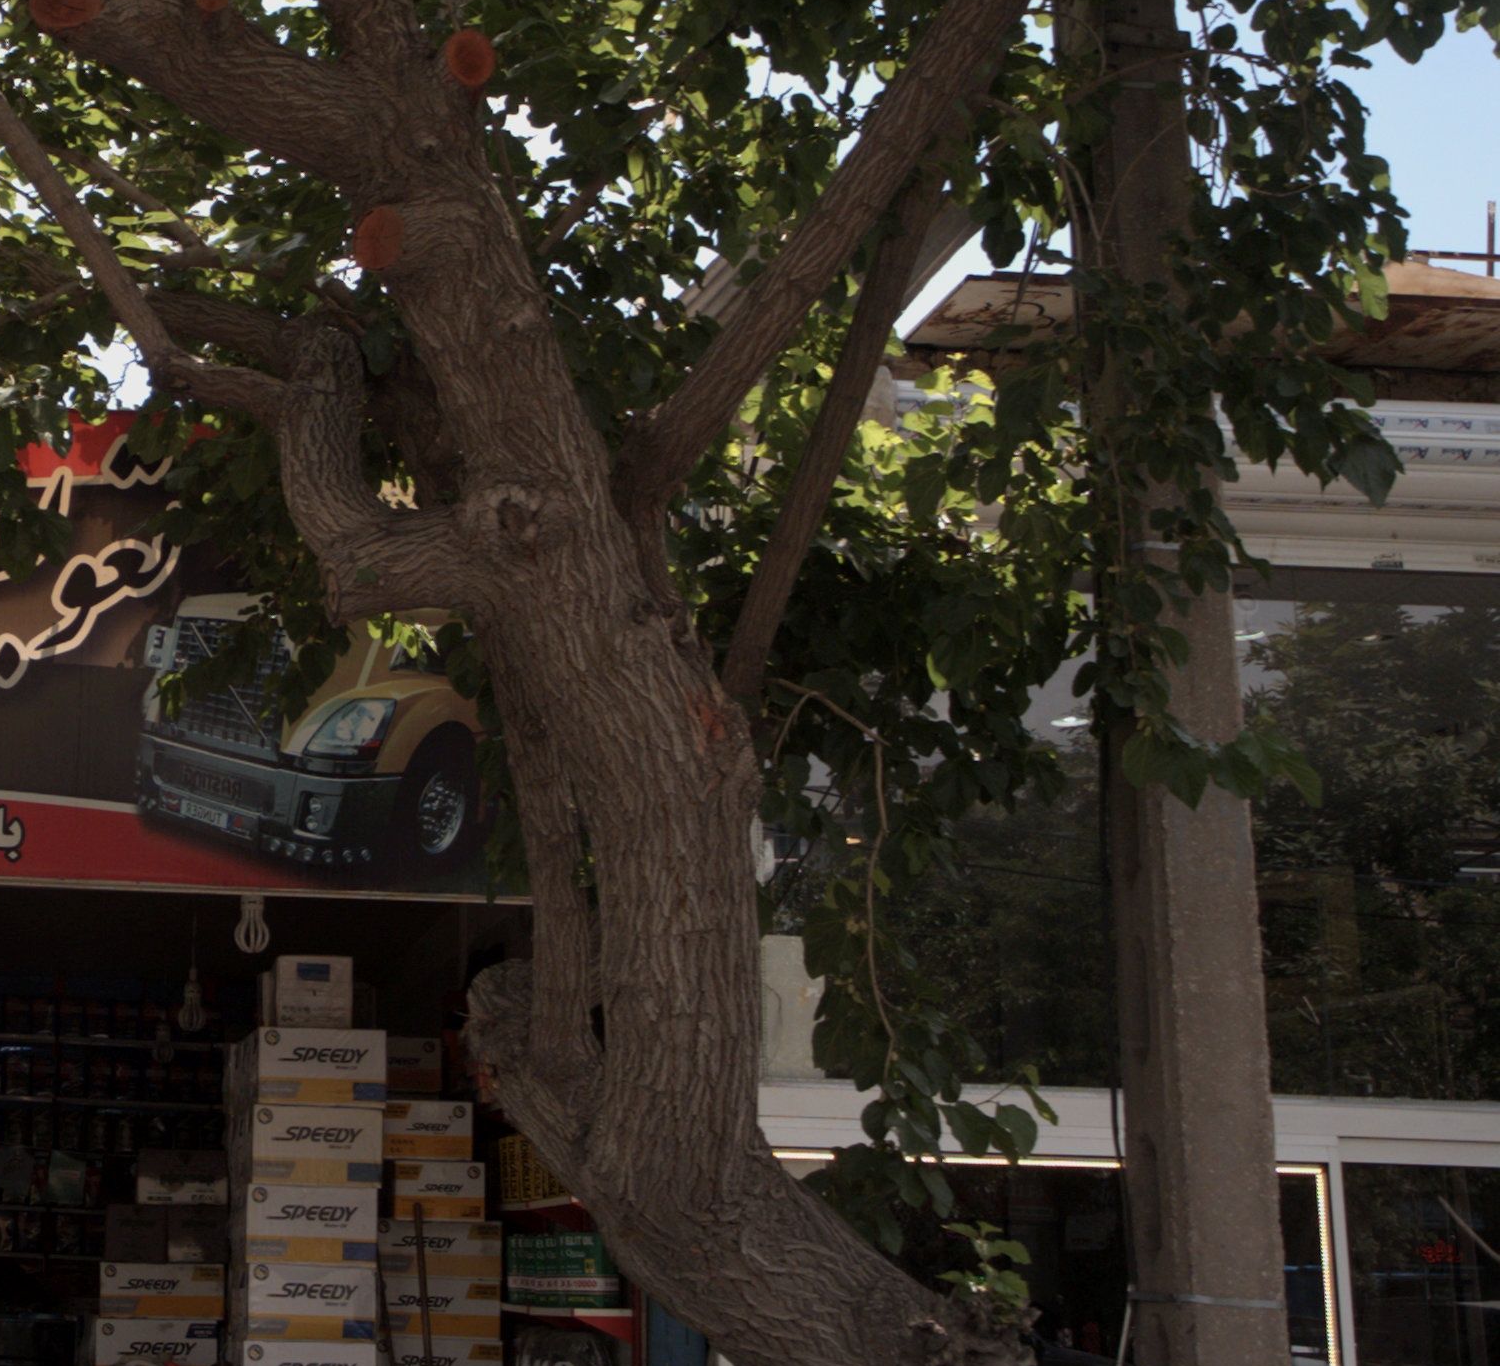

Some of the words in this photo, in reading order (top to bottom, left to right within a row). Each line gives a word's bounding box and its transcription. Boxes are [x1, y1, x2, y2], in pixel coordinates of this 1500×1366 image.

[278, 1047, 369, 1064] SPEEDY
[272, 1126, 363, 1143] SPEEDY
[266, 1205, 358, 1222] SPEEDY
[119, 1279, 179, 1290] SPEEDY
[266, 1282, 358, 1300] SPEEDY
